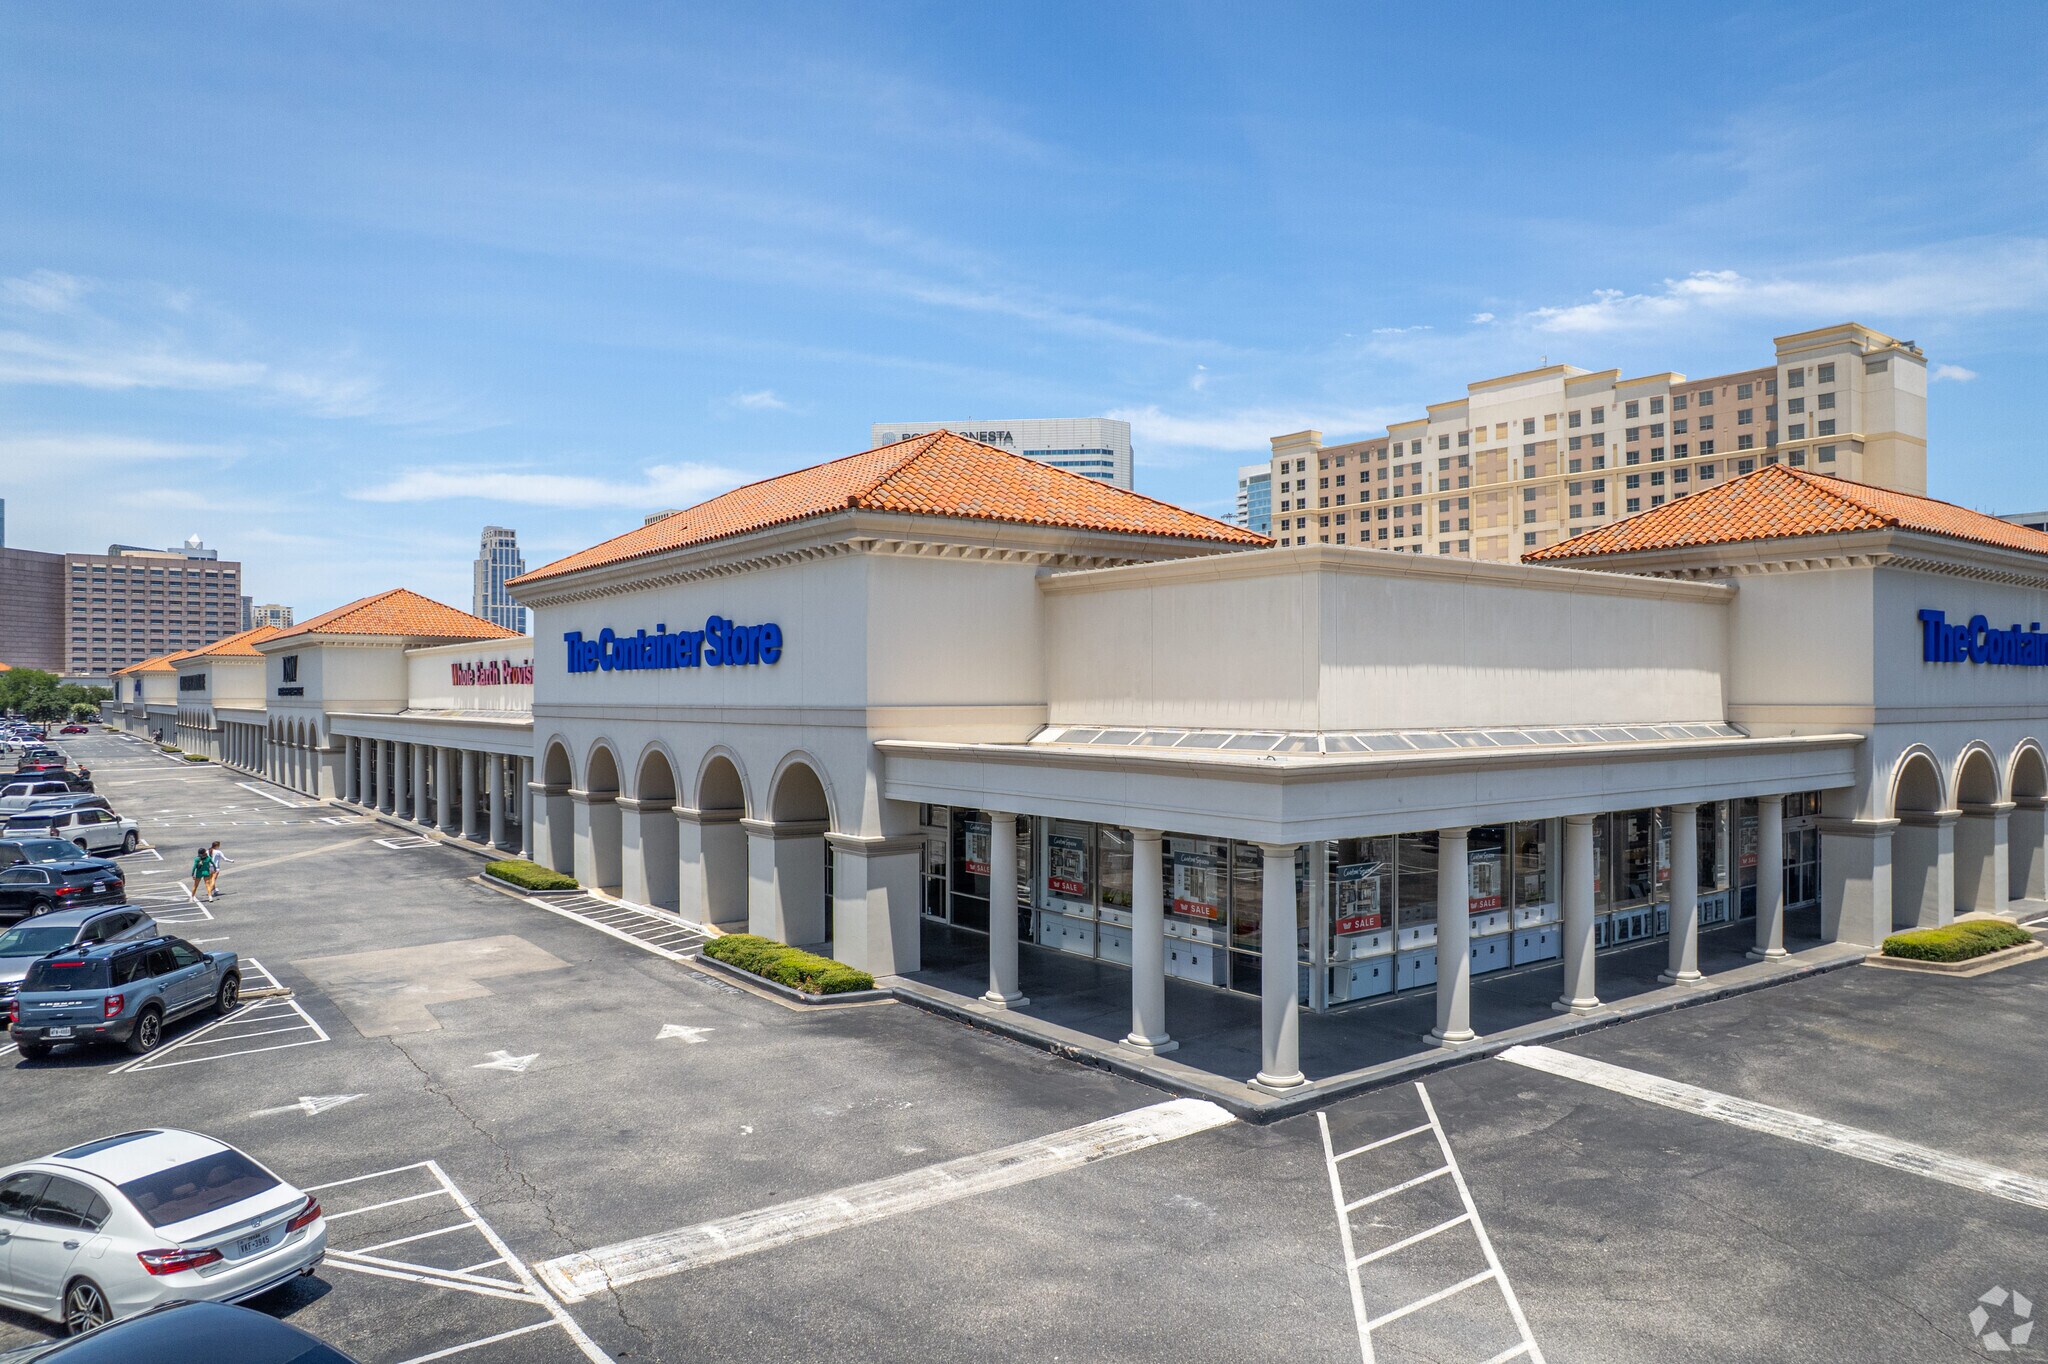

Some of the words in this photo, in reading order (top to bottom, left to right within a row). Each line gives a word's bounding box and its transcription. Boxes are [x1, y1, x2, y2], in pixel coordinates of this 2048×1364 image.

[1918, 609, 1968, 662] The
[564, 632, 599, 673] The
[599, 624, 704, 671] Container
[704, 615, 783, 666] Store
[451, 662, 475, 686] Whole
[476, 661, 501, 685] Earth
[1062, 882, 1078, 891] SALE
[1479, 898, 1496, 908] SALE
[1190, 904, 1210, 915] SALE
[1354, 917, 1375, 929] SALE
